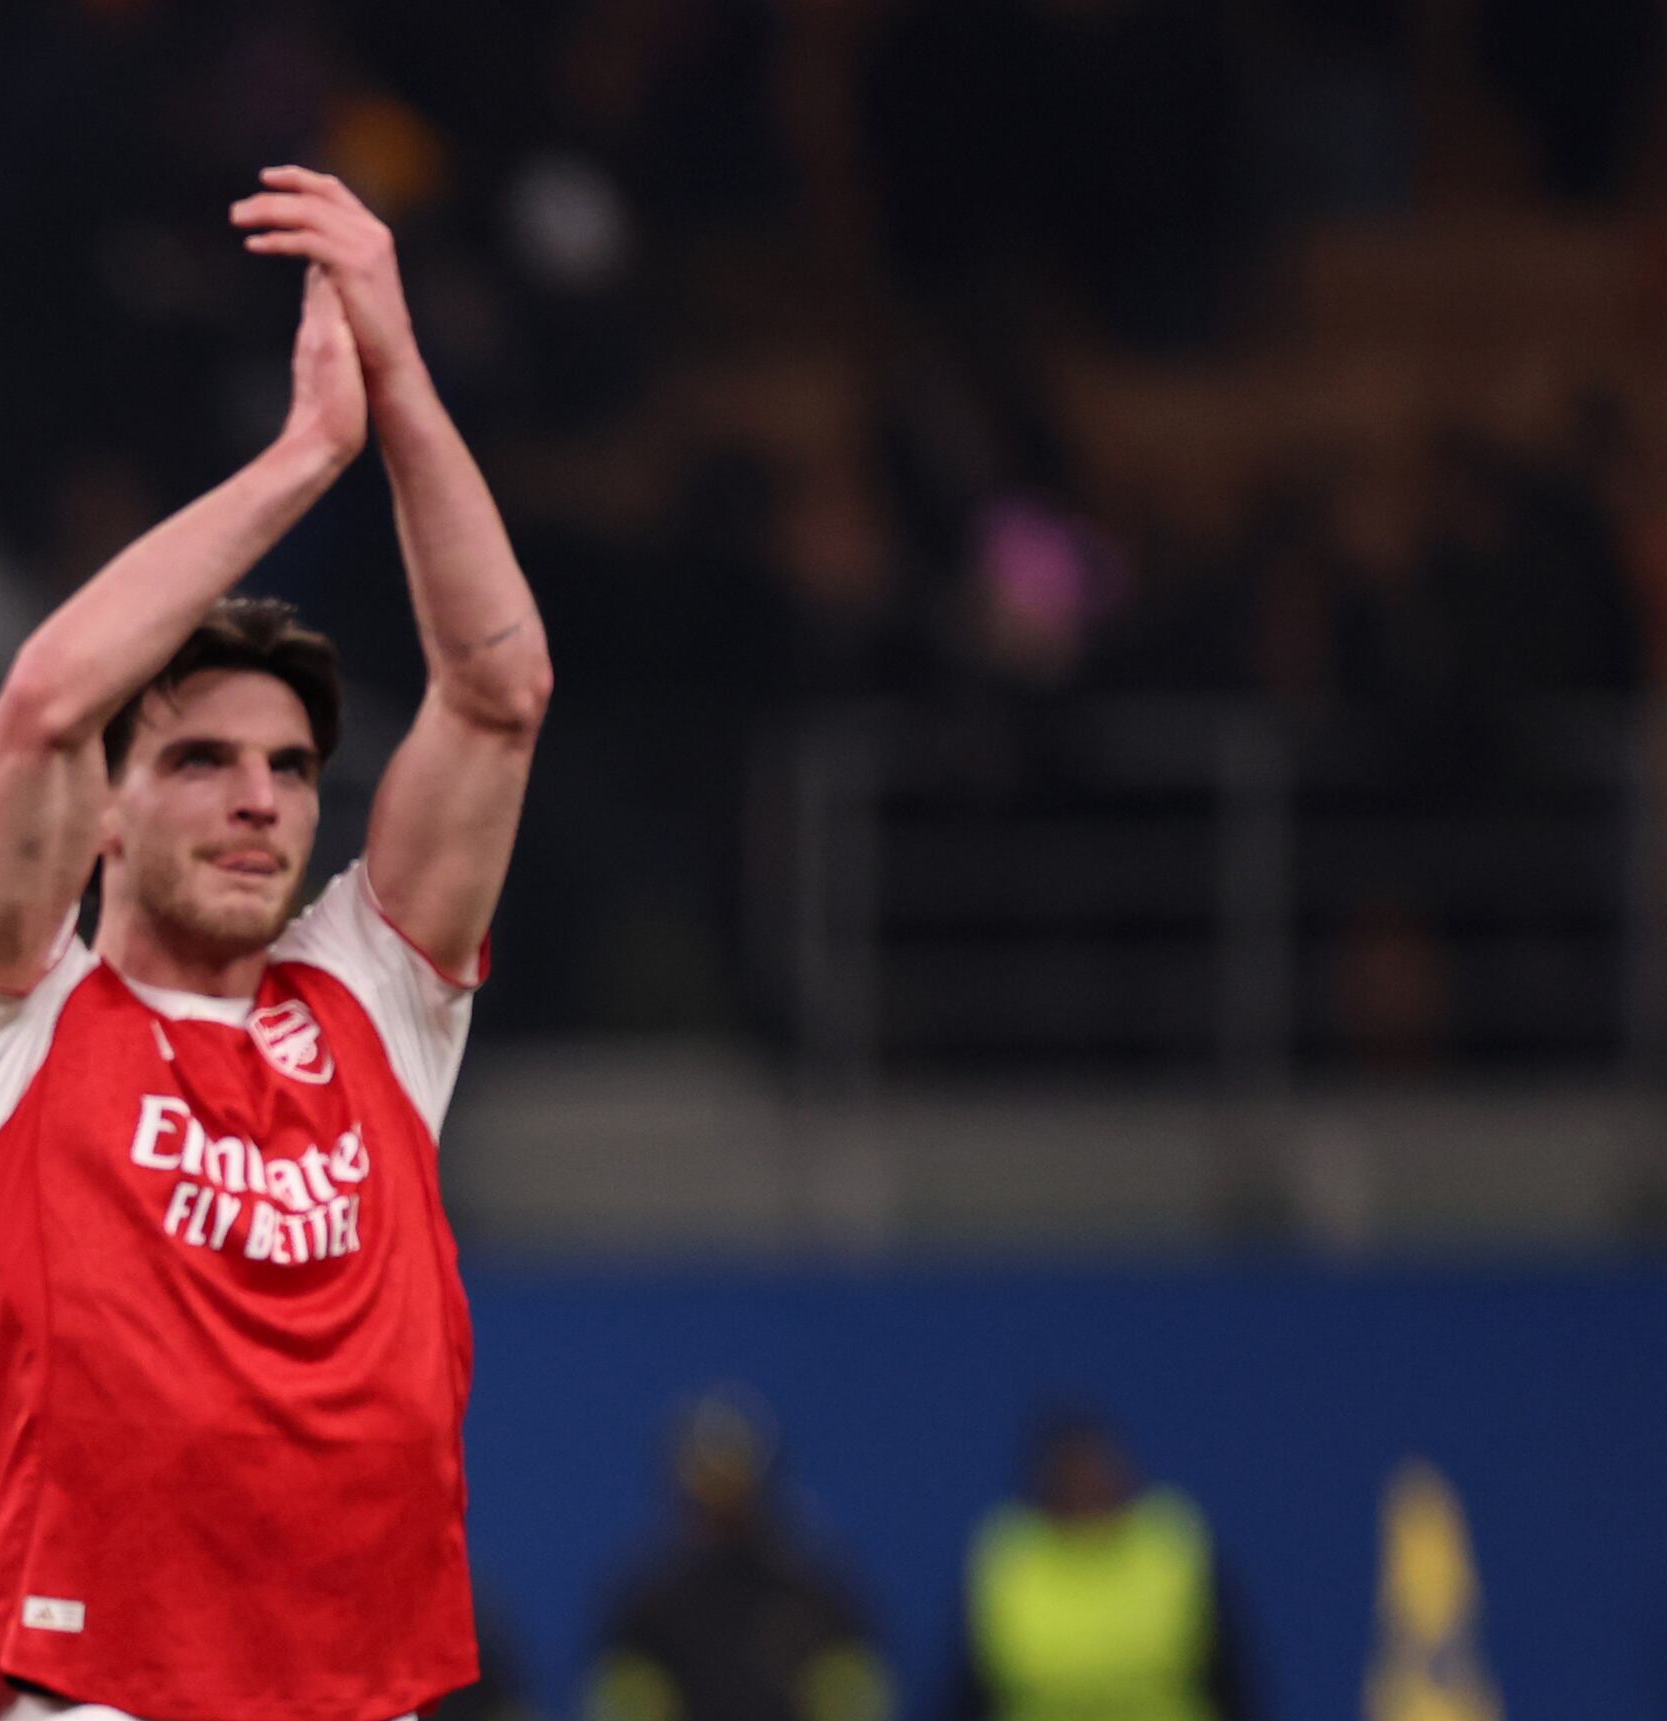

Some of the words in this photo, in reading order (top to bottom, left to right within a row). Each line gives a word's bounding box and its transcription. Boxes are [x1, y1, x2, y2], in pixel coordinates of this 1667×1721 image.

[130, 1094, 370, 1213] Emrate
[163, 1181, 241, 1251] FLY
[244, 1193, 361, 1266] BETTER
